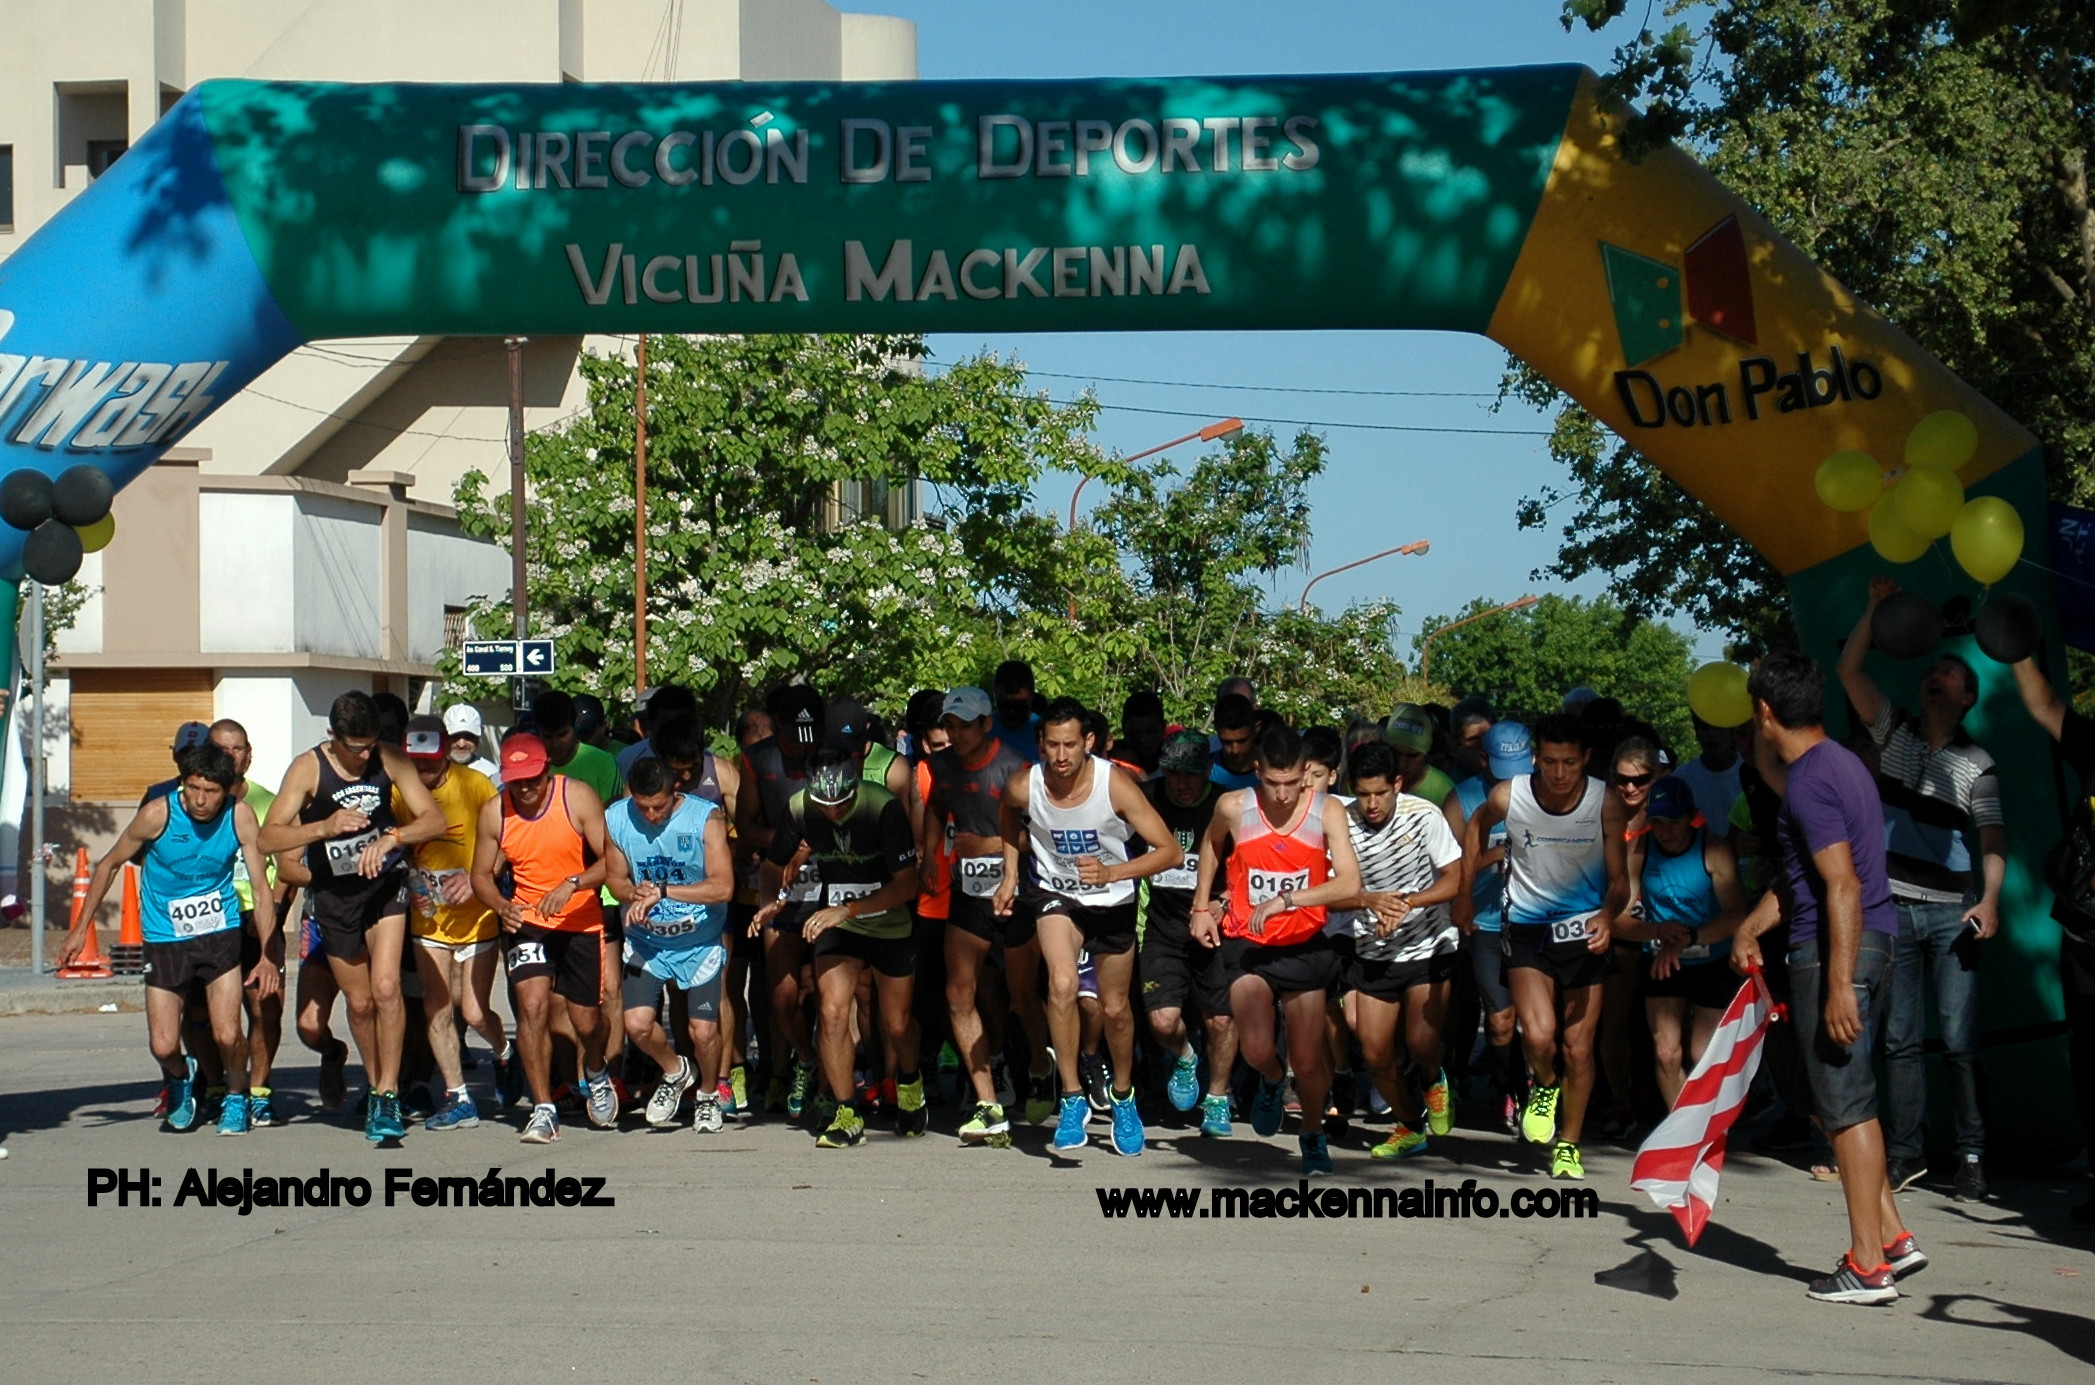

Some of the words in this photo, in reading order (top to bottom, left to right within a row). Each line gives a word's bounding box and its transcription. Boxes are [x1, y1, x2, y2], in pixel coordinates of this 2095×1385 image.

[458, 111, 809, 192] DIRECCIÓN
[840, 117, 932, 184] DE
[978, 114, 1320, 179] DEPORTES
[565, 239, 810, 305] VICUÑA
[844, 239, 1212, 302] MACKENNA
[1614, 370, 1733, 428] Don
[1739, 345, 1882, 421] Pablo
[172, 897, 223, 921] 4020
[1250, 874, 1307, 893] 0167
